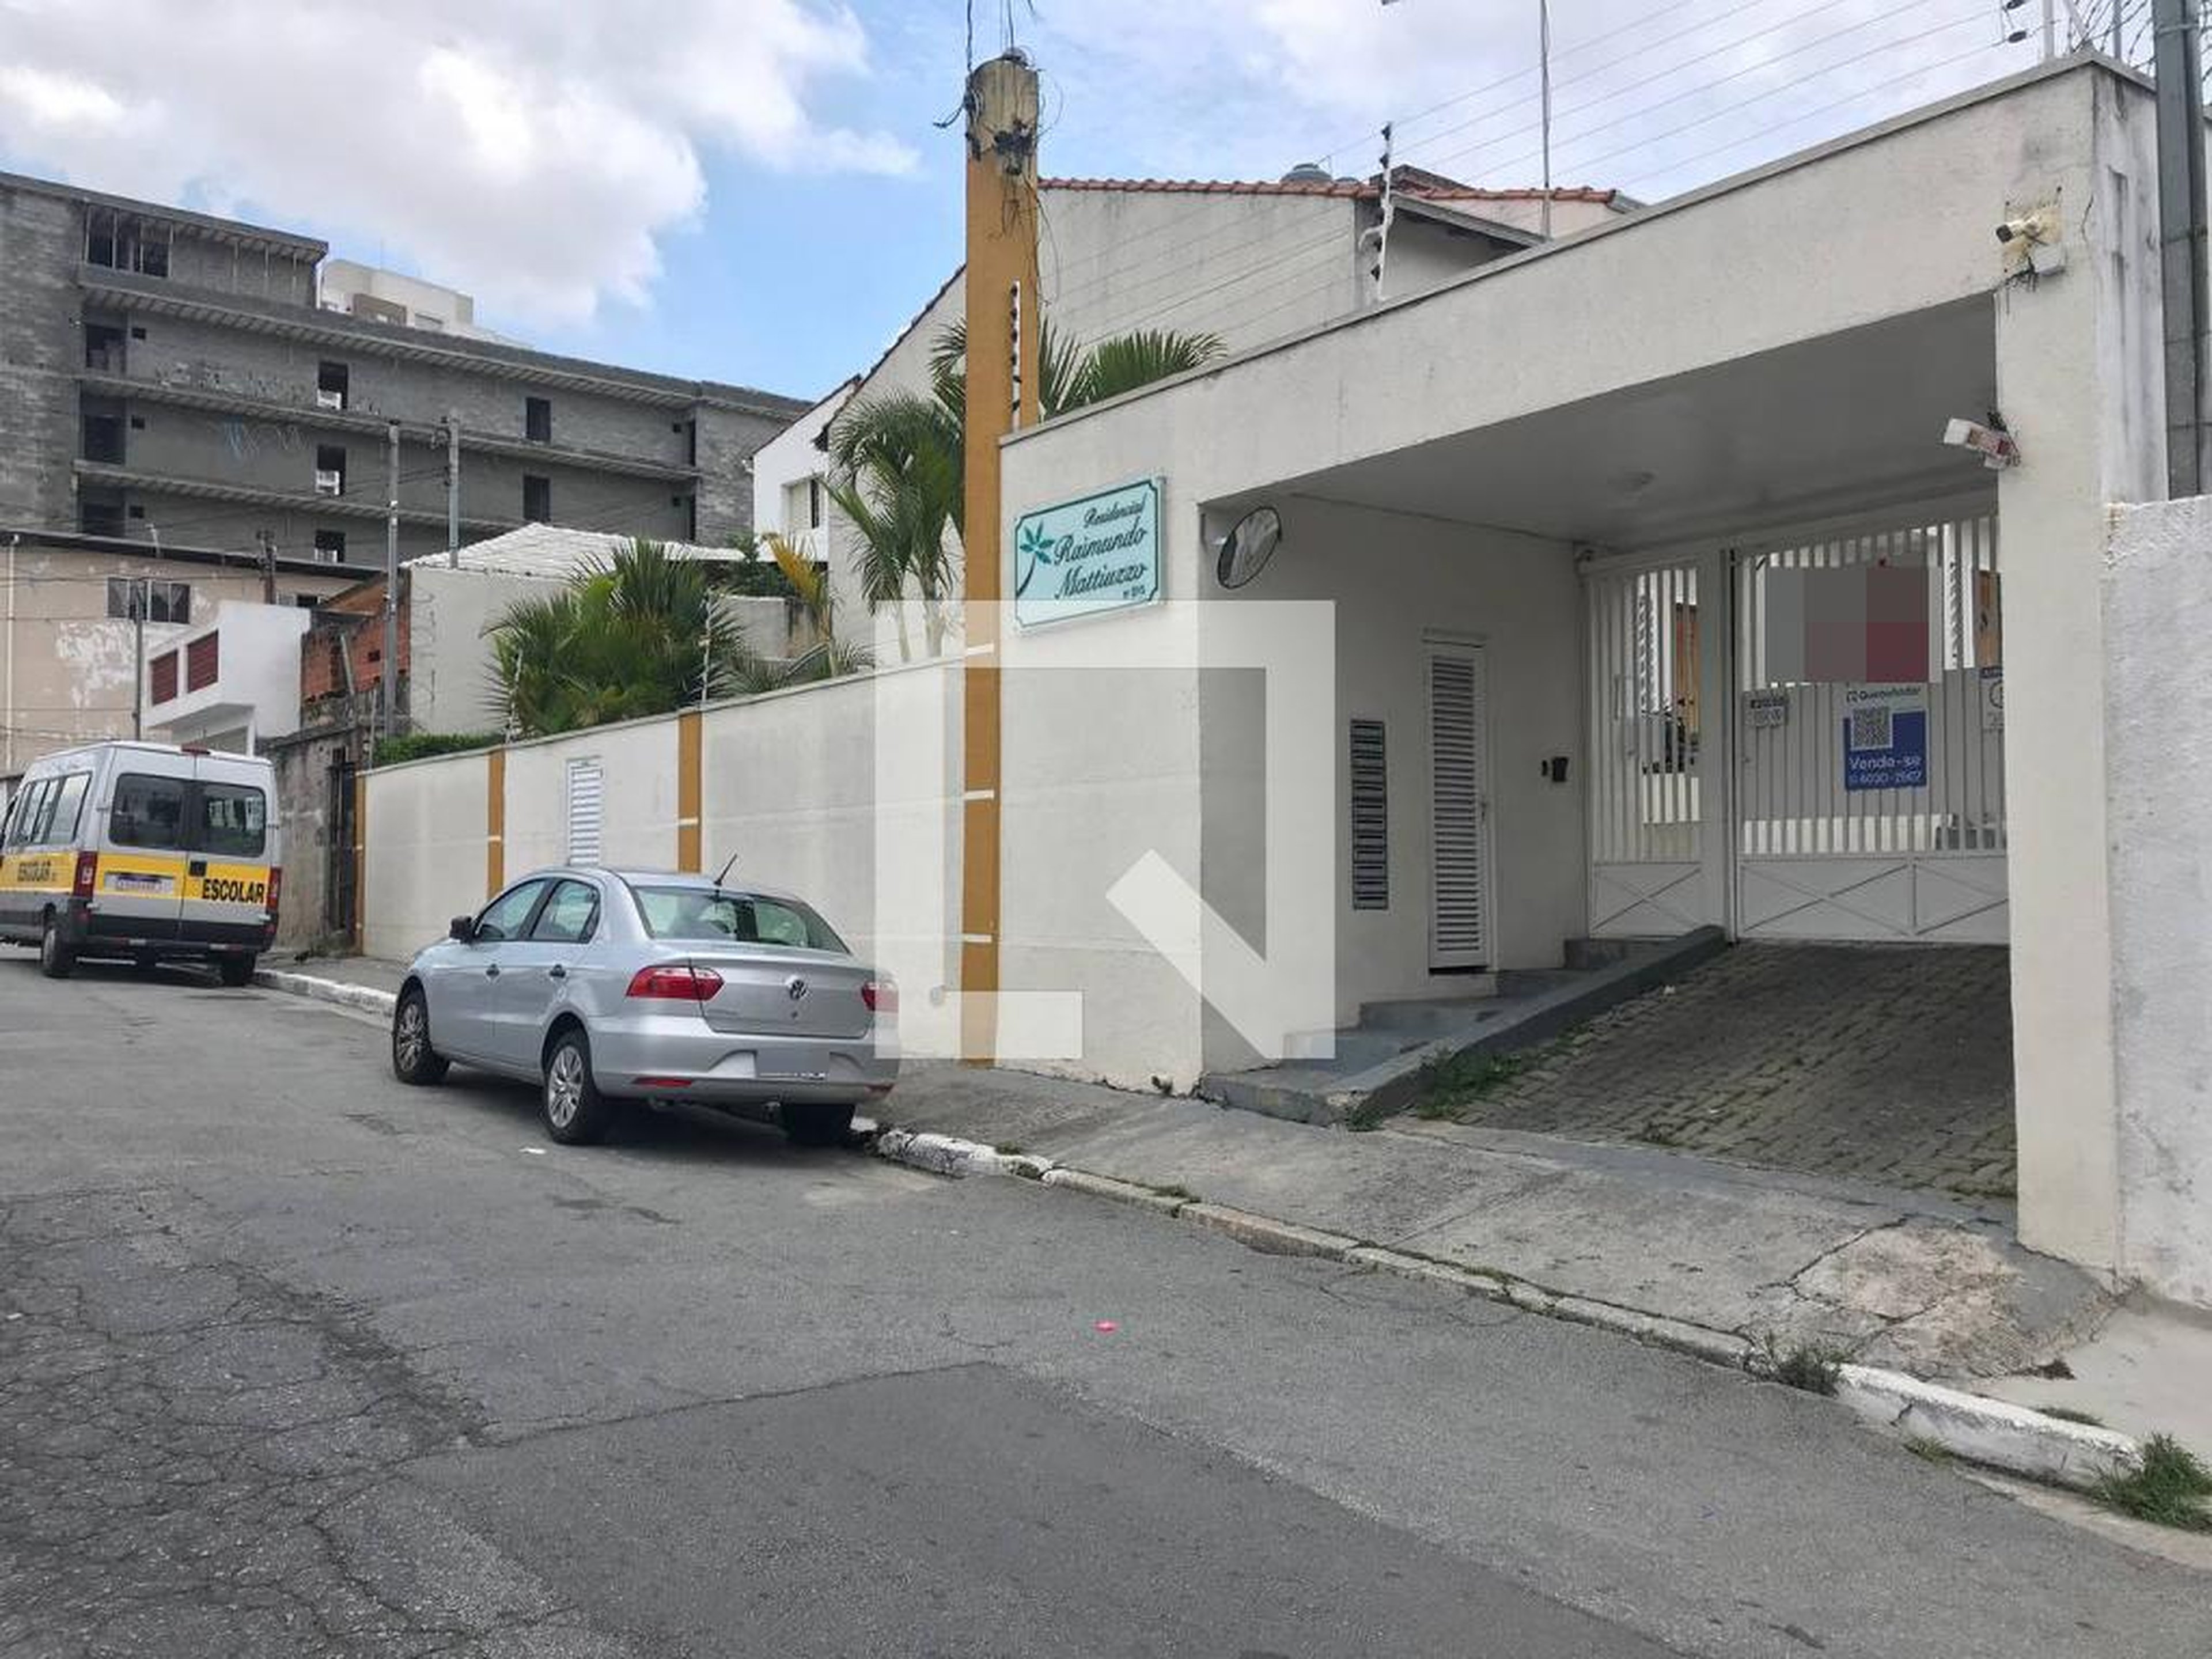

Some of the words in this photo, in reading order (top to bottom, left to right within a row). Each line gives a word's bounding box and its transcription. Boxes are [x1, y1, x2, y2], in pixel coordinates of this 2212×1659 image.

[1084, 492, 1147, 528] Residencial
[1054, 516, 1147, 565] Raimundo
[1055, 564, 1147, 600] Mattiuzzo
[202, 878, 264, 904] ESCOLAR
